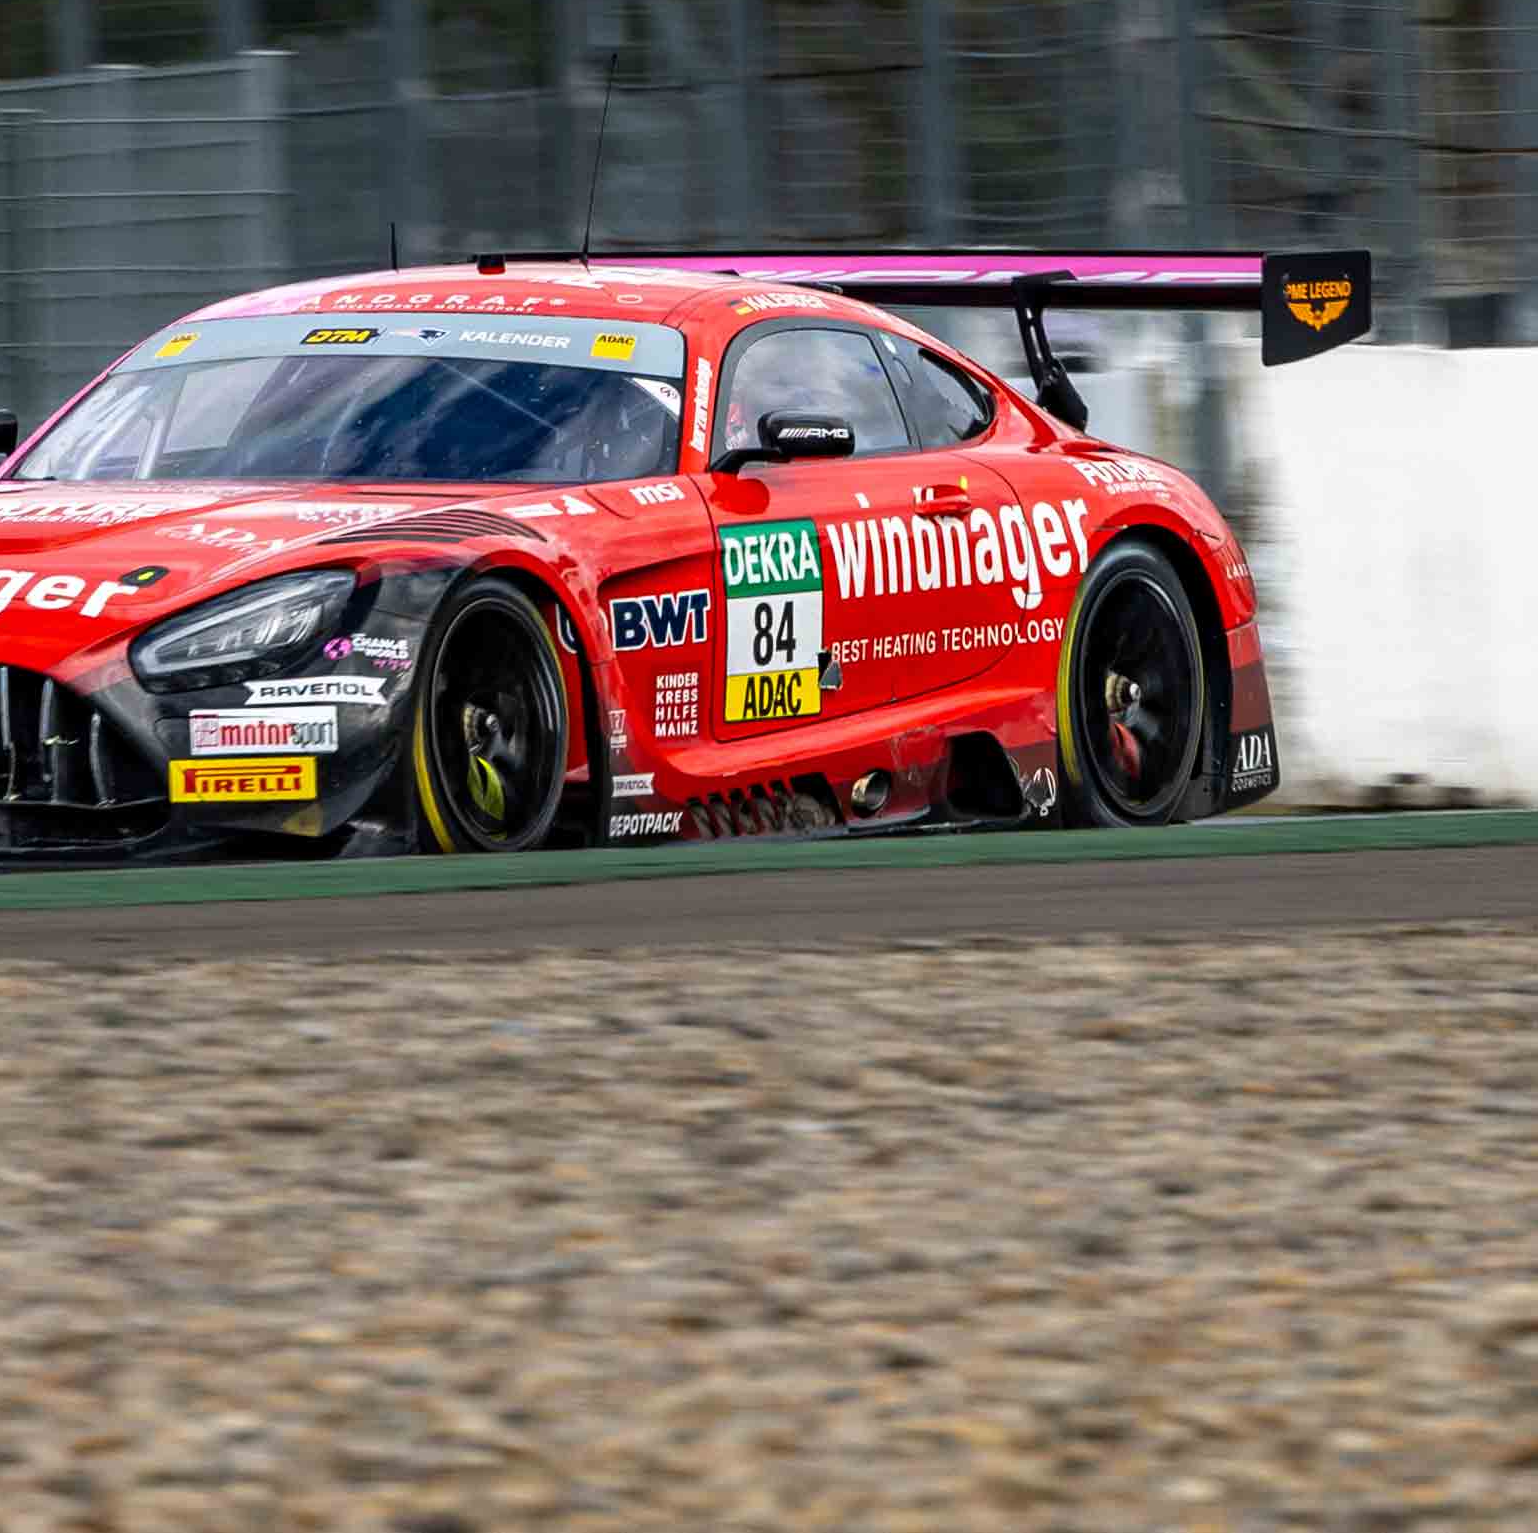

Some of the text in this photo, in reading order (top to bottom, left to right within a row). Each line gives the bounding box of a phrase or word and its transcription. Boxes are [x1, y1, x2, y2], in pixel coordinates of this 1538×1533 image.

[1310, 281, 1352, 298] LEGEND
[304, 329, 371, 344] DTM
[458, 330, 571, 349] KALENDER
[597, 334, 635, 347] ADAC
[629, 482, 685, 506] msi
[724, 529, 820, 586] DEKRA
[610, 588, 711, 650] BWT
[752, 600, 797, 666] 84
[832, 617, 1065, 664] BEST HEATING TECHNOLOGY
[259, 682, 375, 697] RAVENOL
[656, 672, 699, 689] KINDER
[655, 689, 699, 705] KREBS
[742, 672, 803, 719] ADAC
[655, 705, 698, 721] HILFE
[655, 720, 698, 737] MAINZ
[1233, 732, 1272, 772] ADA
[184, 765, 302, 794] PIRELLI
[609, 811, 683, 838] DEPOTPACK
